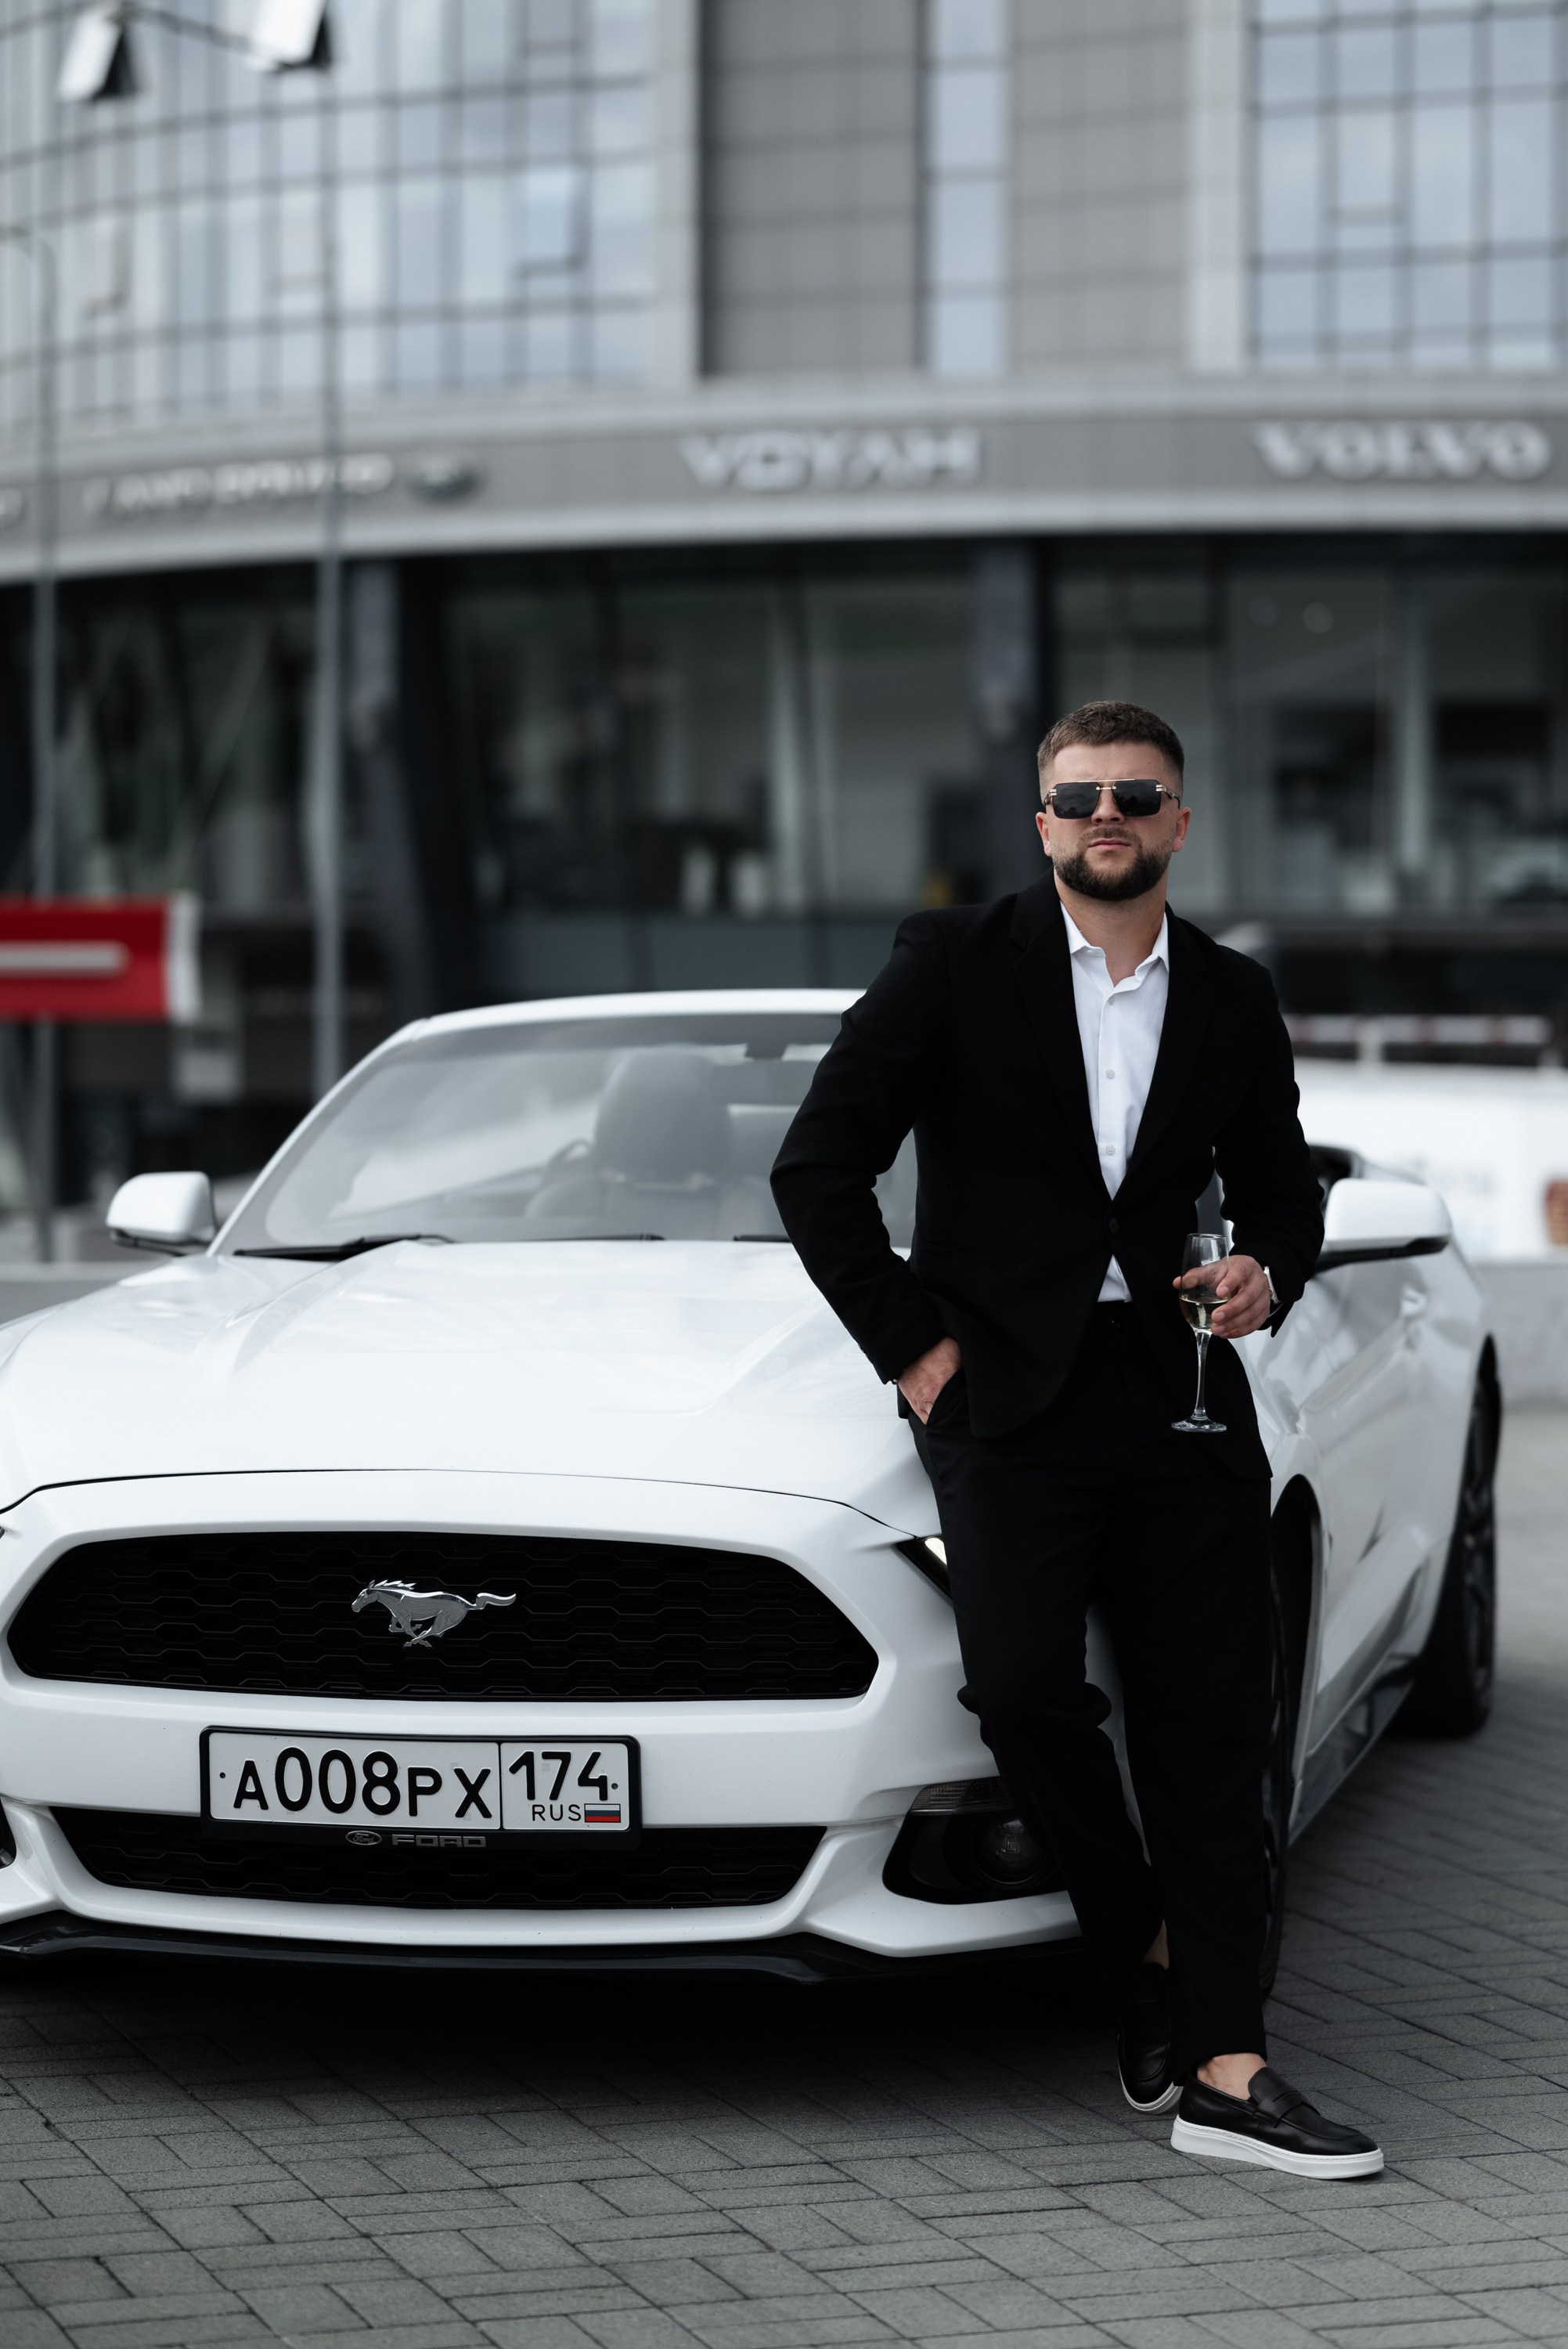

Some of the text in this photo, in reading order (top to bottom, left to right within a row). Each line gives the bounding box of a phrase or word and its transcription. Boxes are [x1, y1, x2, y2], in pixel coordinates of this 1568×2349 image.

[1255, 420, 1551, 480] VOLVO
[509, 1751, 608, 1801] 174
[532, 1803, 582, 1821] RUS
[392, 1834, 487, 1848] FORD
